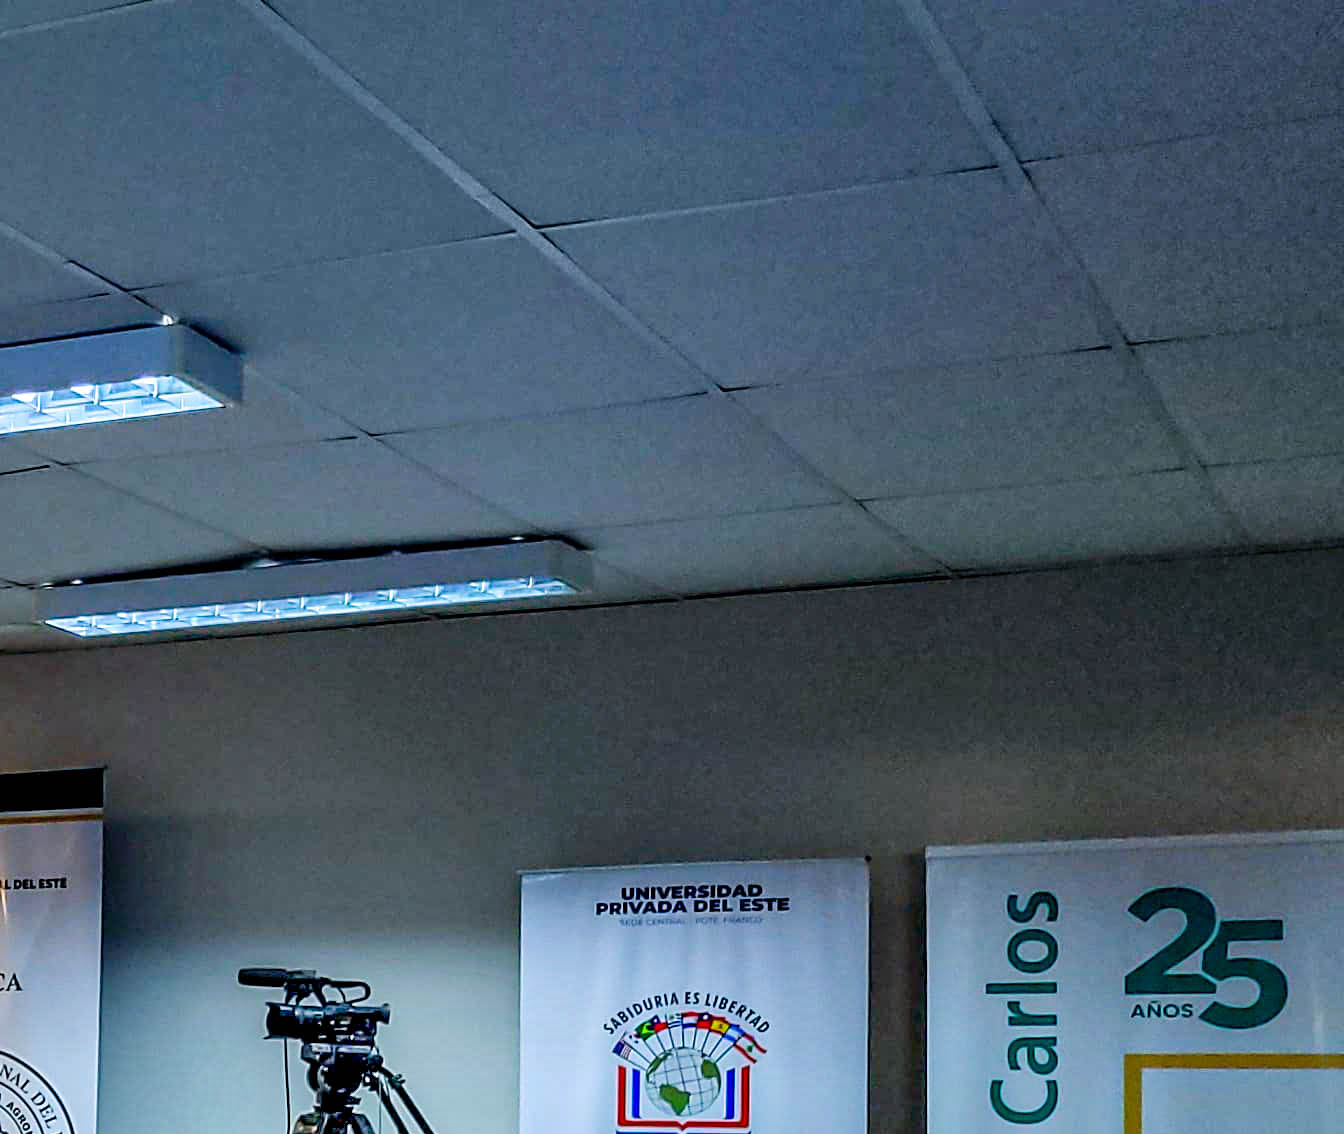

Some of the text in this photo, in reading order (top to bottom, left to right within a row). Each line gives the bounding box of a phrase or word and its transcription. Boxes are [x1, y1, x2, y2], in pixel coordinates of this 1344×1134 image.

[13, 879, 37, 890] DEL
[38, 877, 67, 889] ESTE
[621, 884, 763, 901] UNIVERSIDAD
[596, 897, 790, 915] PRIVADA DEL ESTE
[1124, 886, 1289, 1030] 25
[603, 991, 770, 1034] SABIDURIA ES LIBERTAD
[985, 890, 1059, 1125] Carlos
[1130, 1001, 1194, 1019] AÑOS
[31, 1091, 59, 1129] DEL
